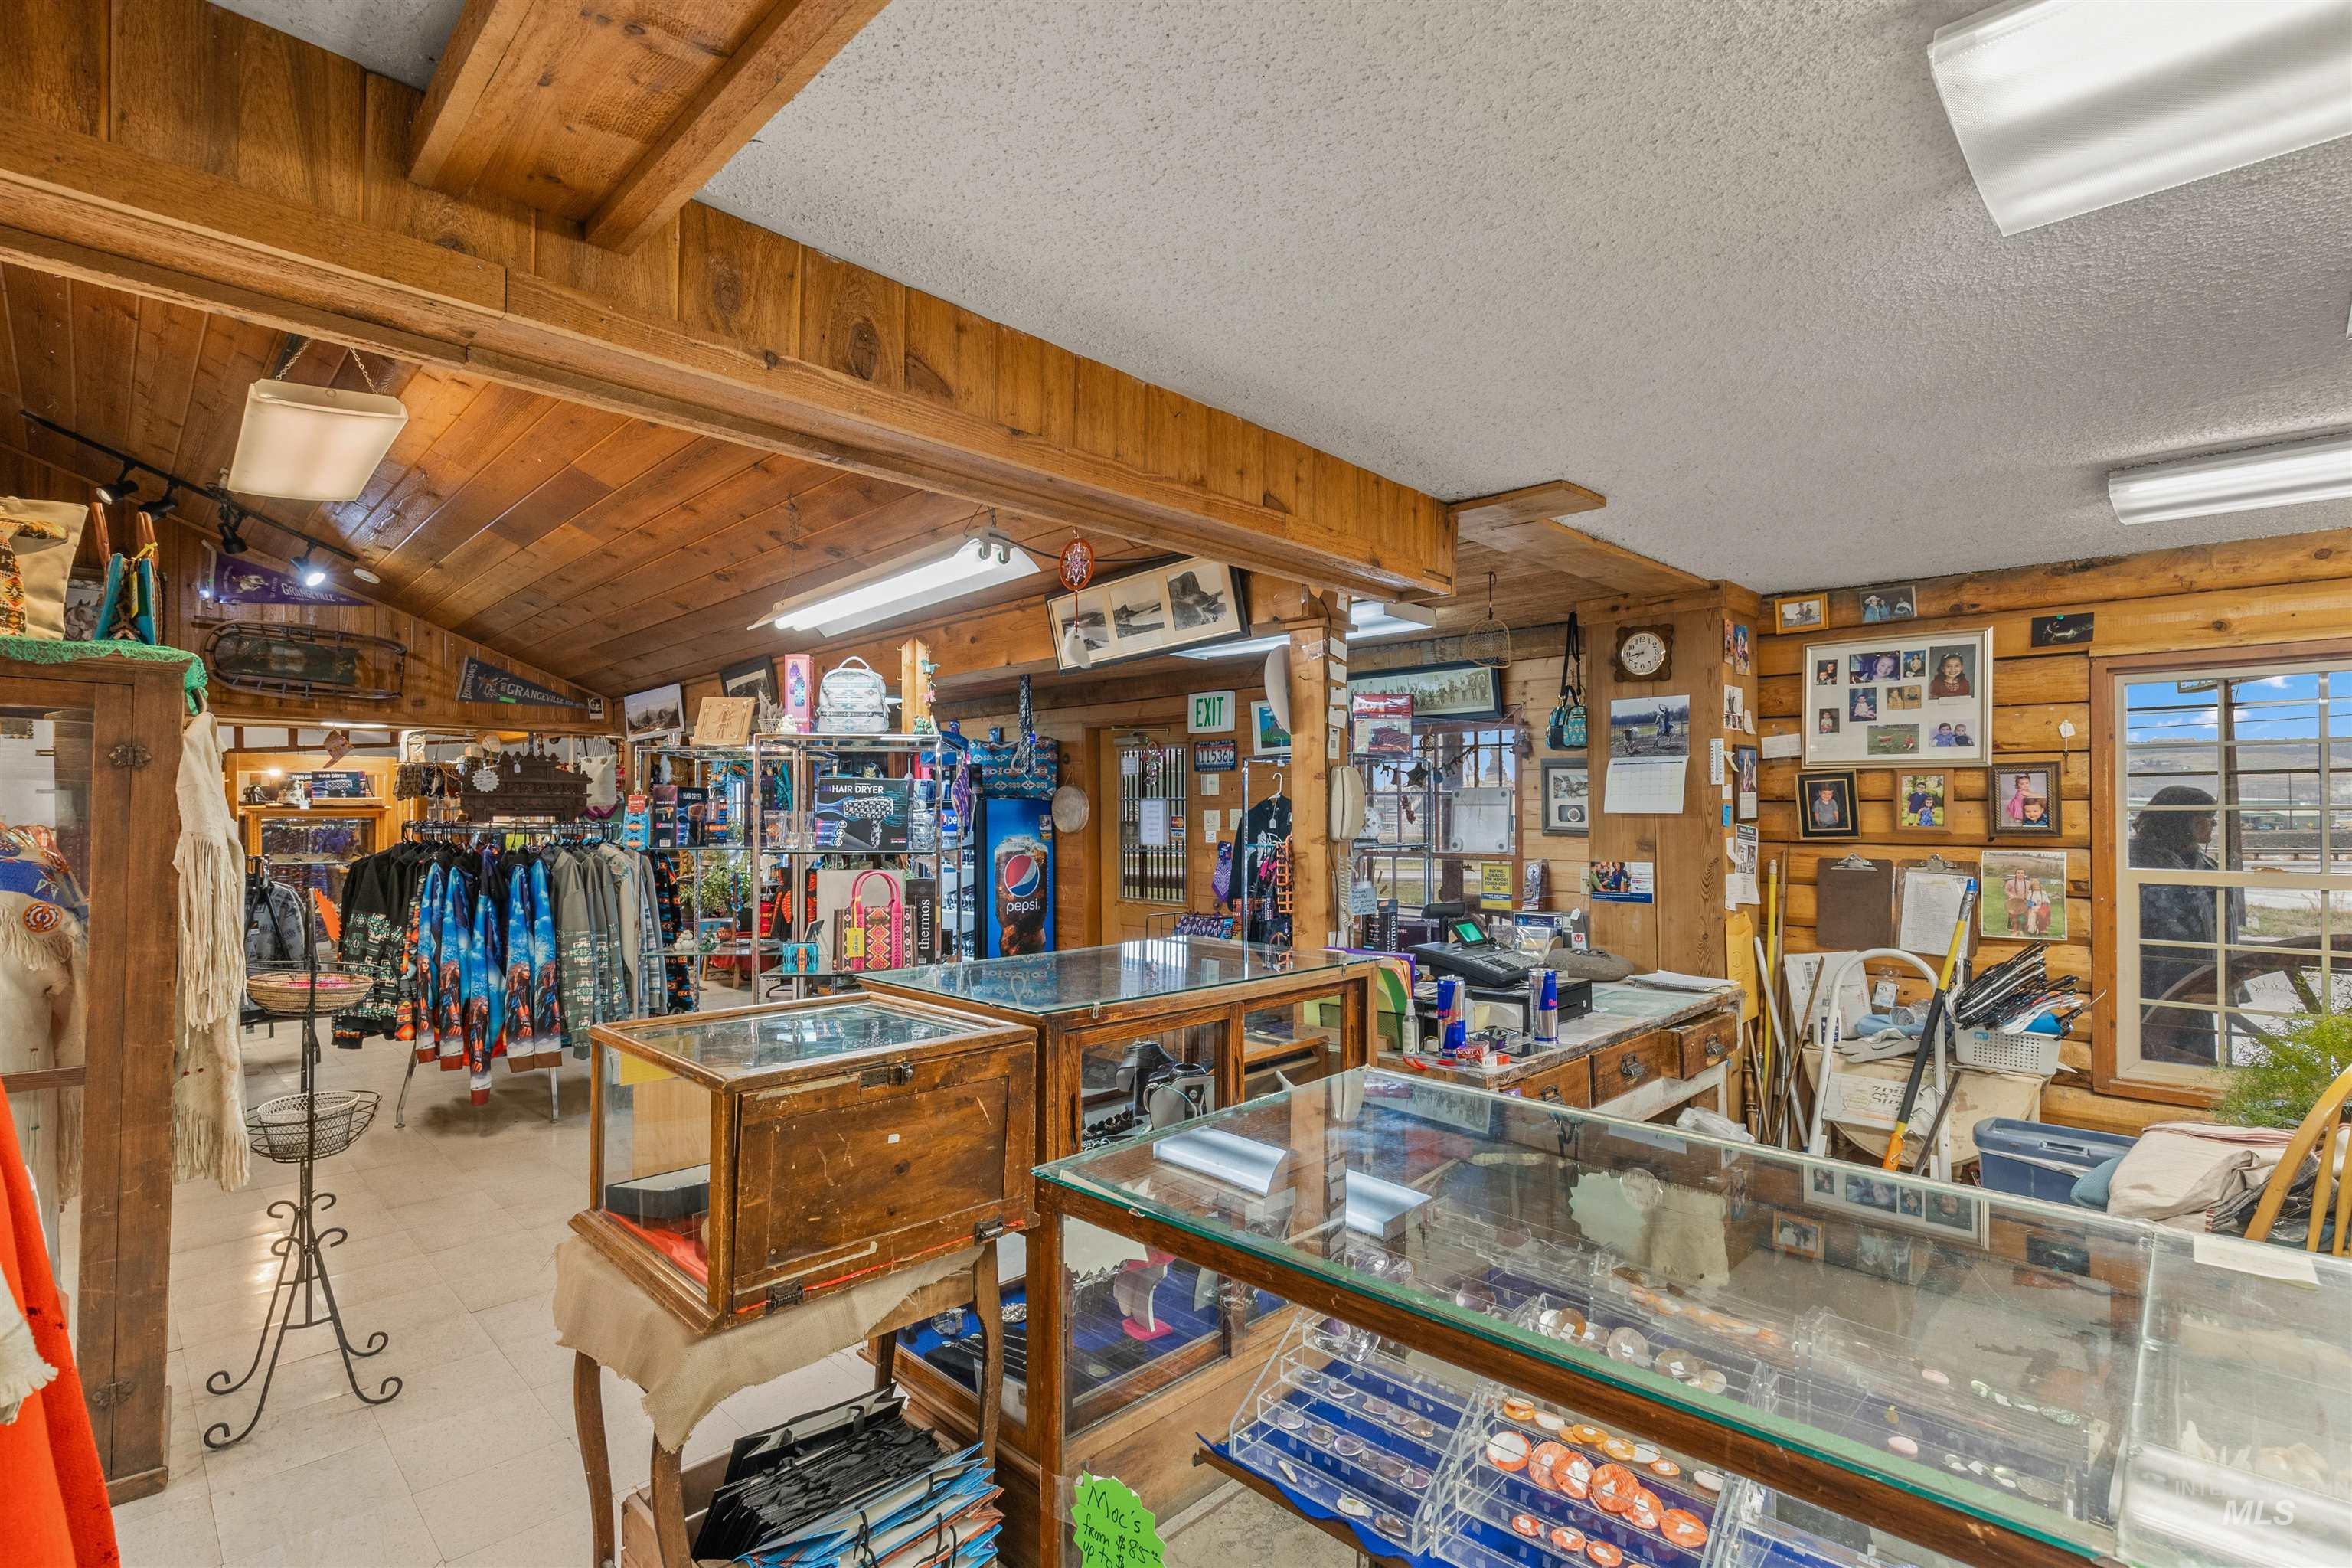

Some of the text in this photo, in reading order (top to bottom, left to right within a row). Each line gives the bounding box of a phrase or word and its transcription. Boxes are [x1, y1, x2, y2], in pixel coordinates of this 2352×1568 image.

[281, 583, 335, 602] GRANGEVILLE
[507, 682, 564, 704] GRANGEVILLE
[1196, 697, 1224, 727] EXIT
[832, 785, 853, 793] HAIR
[855, 785, 884, 794] DRYER
[1006, 898, 1038, 915] pepsi
[919, 899, 930, 949] thermos
[1087, 1485, 1141, 1533] Moc's
[1083, 1513, 1109, 1547] from
[1083, 1541, 1094, 1563] up
